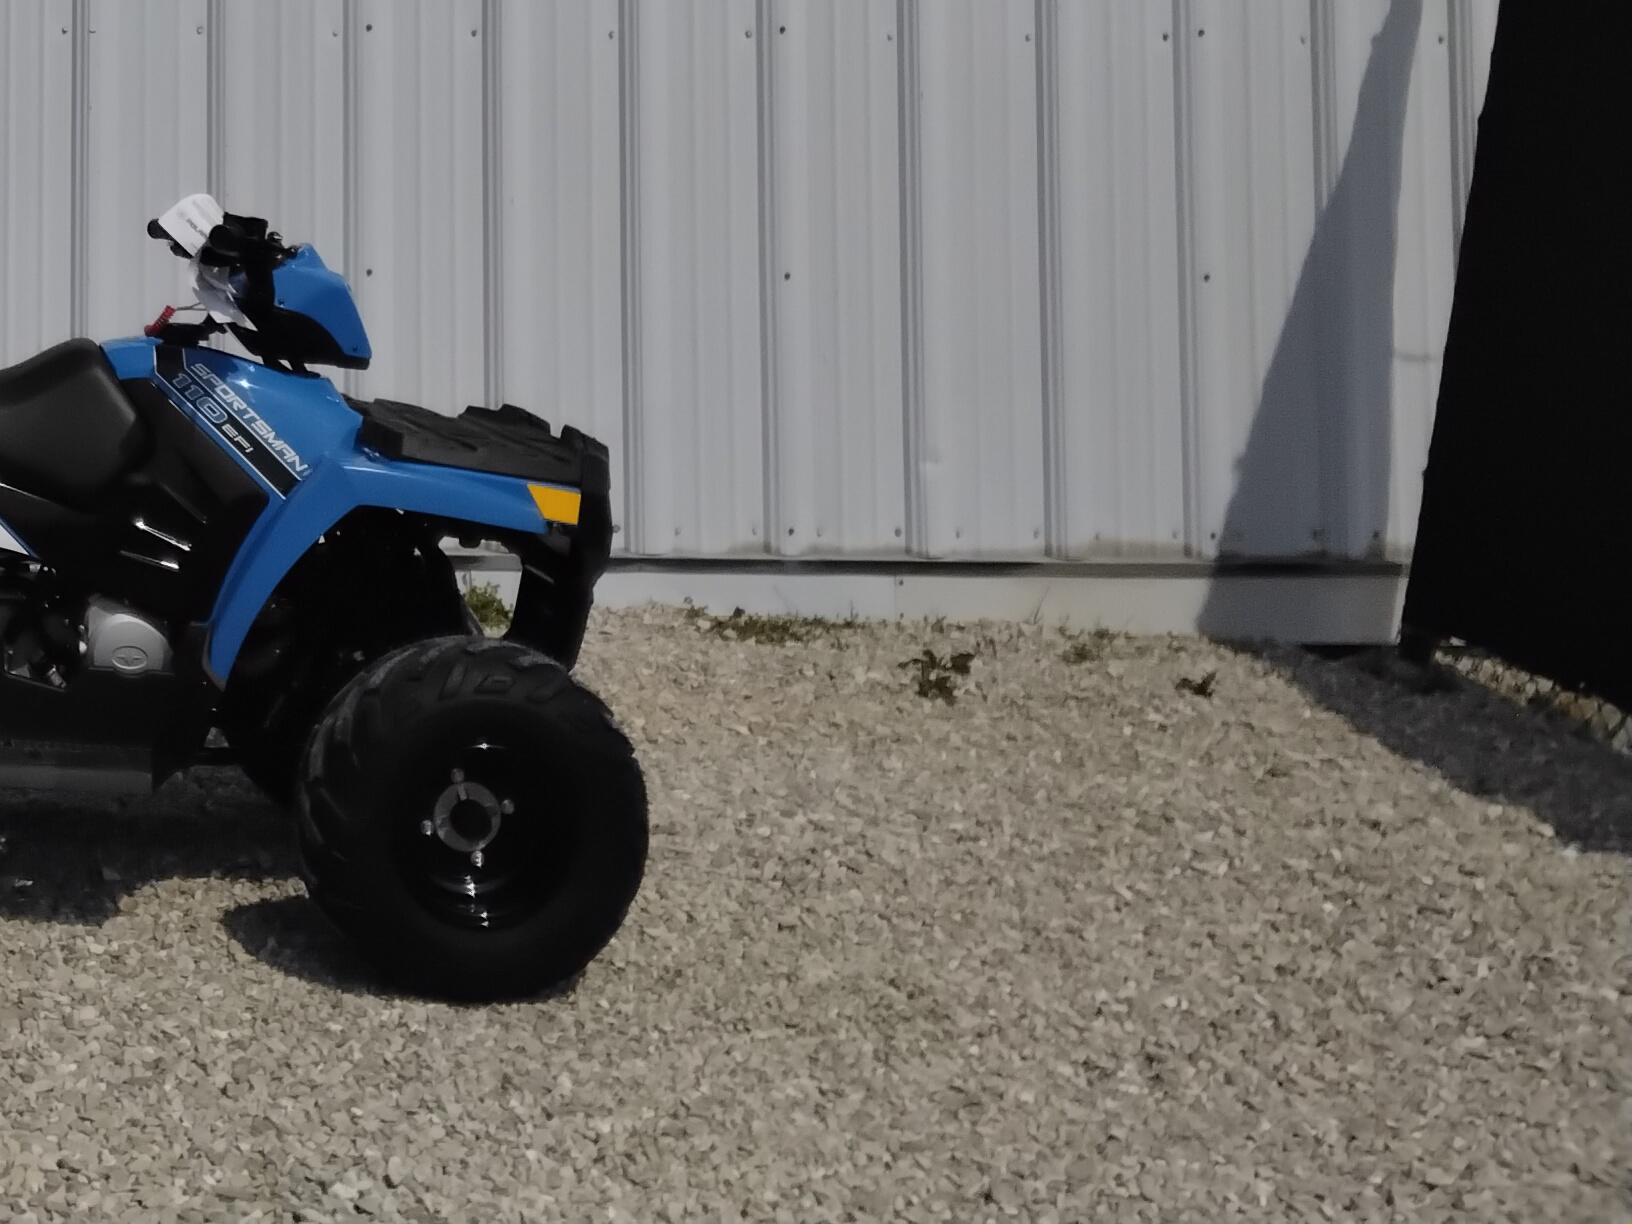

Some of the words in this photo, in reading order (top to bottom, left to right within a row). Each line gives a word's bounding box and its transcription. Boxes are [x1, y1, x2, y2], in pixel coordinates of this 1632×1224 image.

[172, 373, 228, 424] 110
[222, 424, 254, 453] EFI
[191, 363, 309, 473] SPORTSMAN
